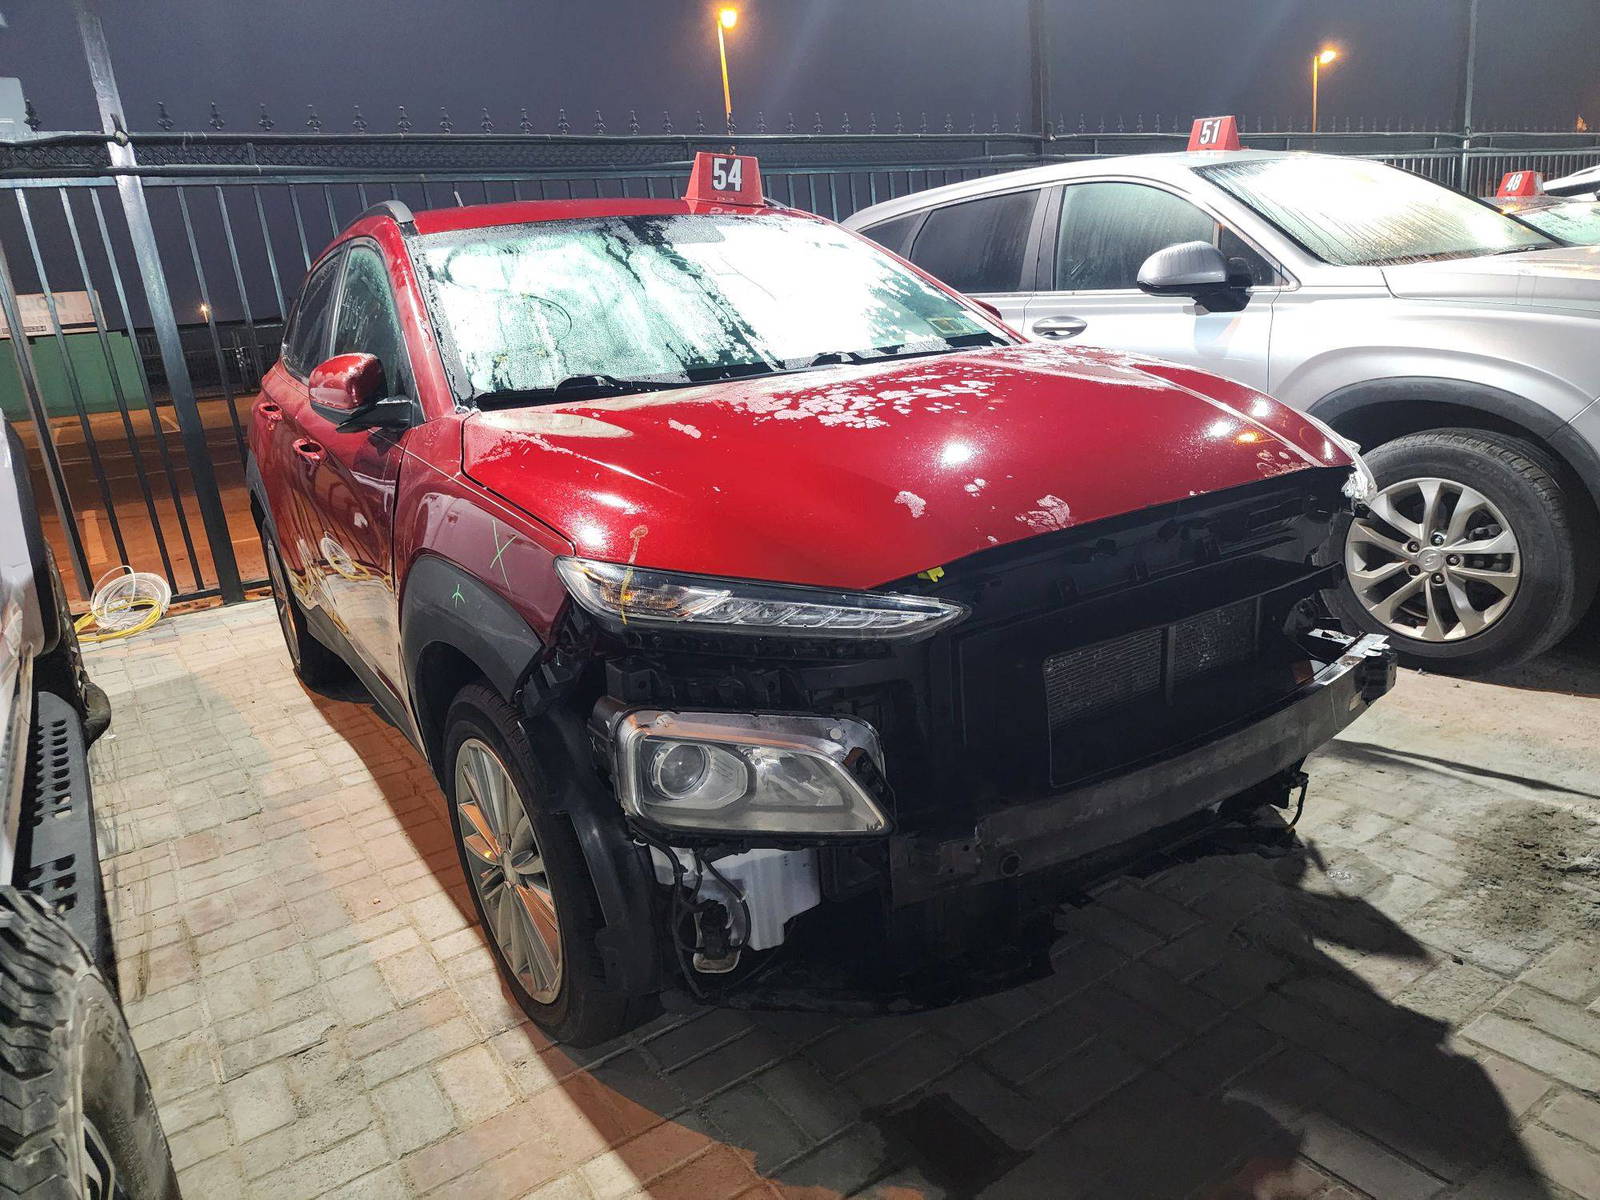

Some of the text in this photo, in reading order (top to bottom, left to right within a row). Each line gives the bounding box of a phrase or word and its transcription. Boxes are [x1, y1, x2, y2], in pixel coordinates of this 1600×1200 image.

[1200, 119, 1221, 145] 51
[713, 157, 742, 192] 54
[1505, 173, 1523, 192] 48
